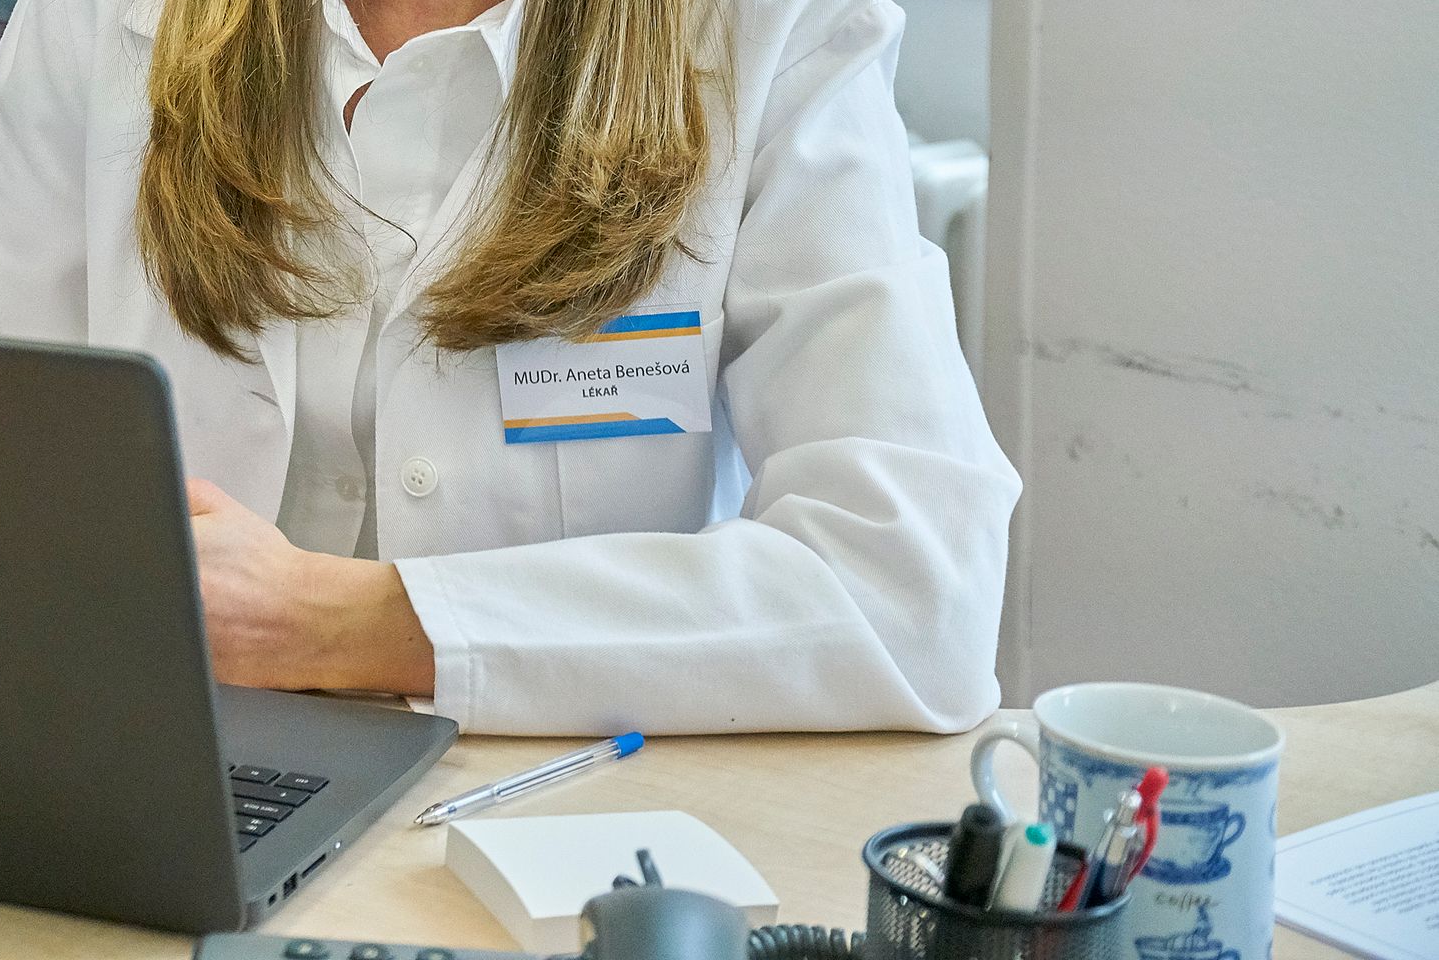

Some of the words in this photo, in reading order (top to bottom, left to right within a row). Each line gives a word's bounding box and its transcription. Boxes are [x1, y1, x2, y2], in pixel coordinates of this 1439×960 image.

[514, 369, 562, 385] MUDr.
[566, 367, 611, 382] Aneta
[616, 360, 690, 379] Benešová
[582, 385, 618, 398] LÉKAŘ
